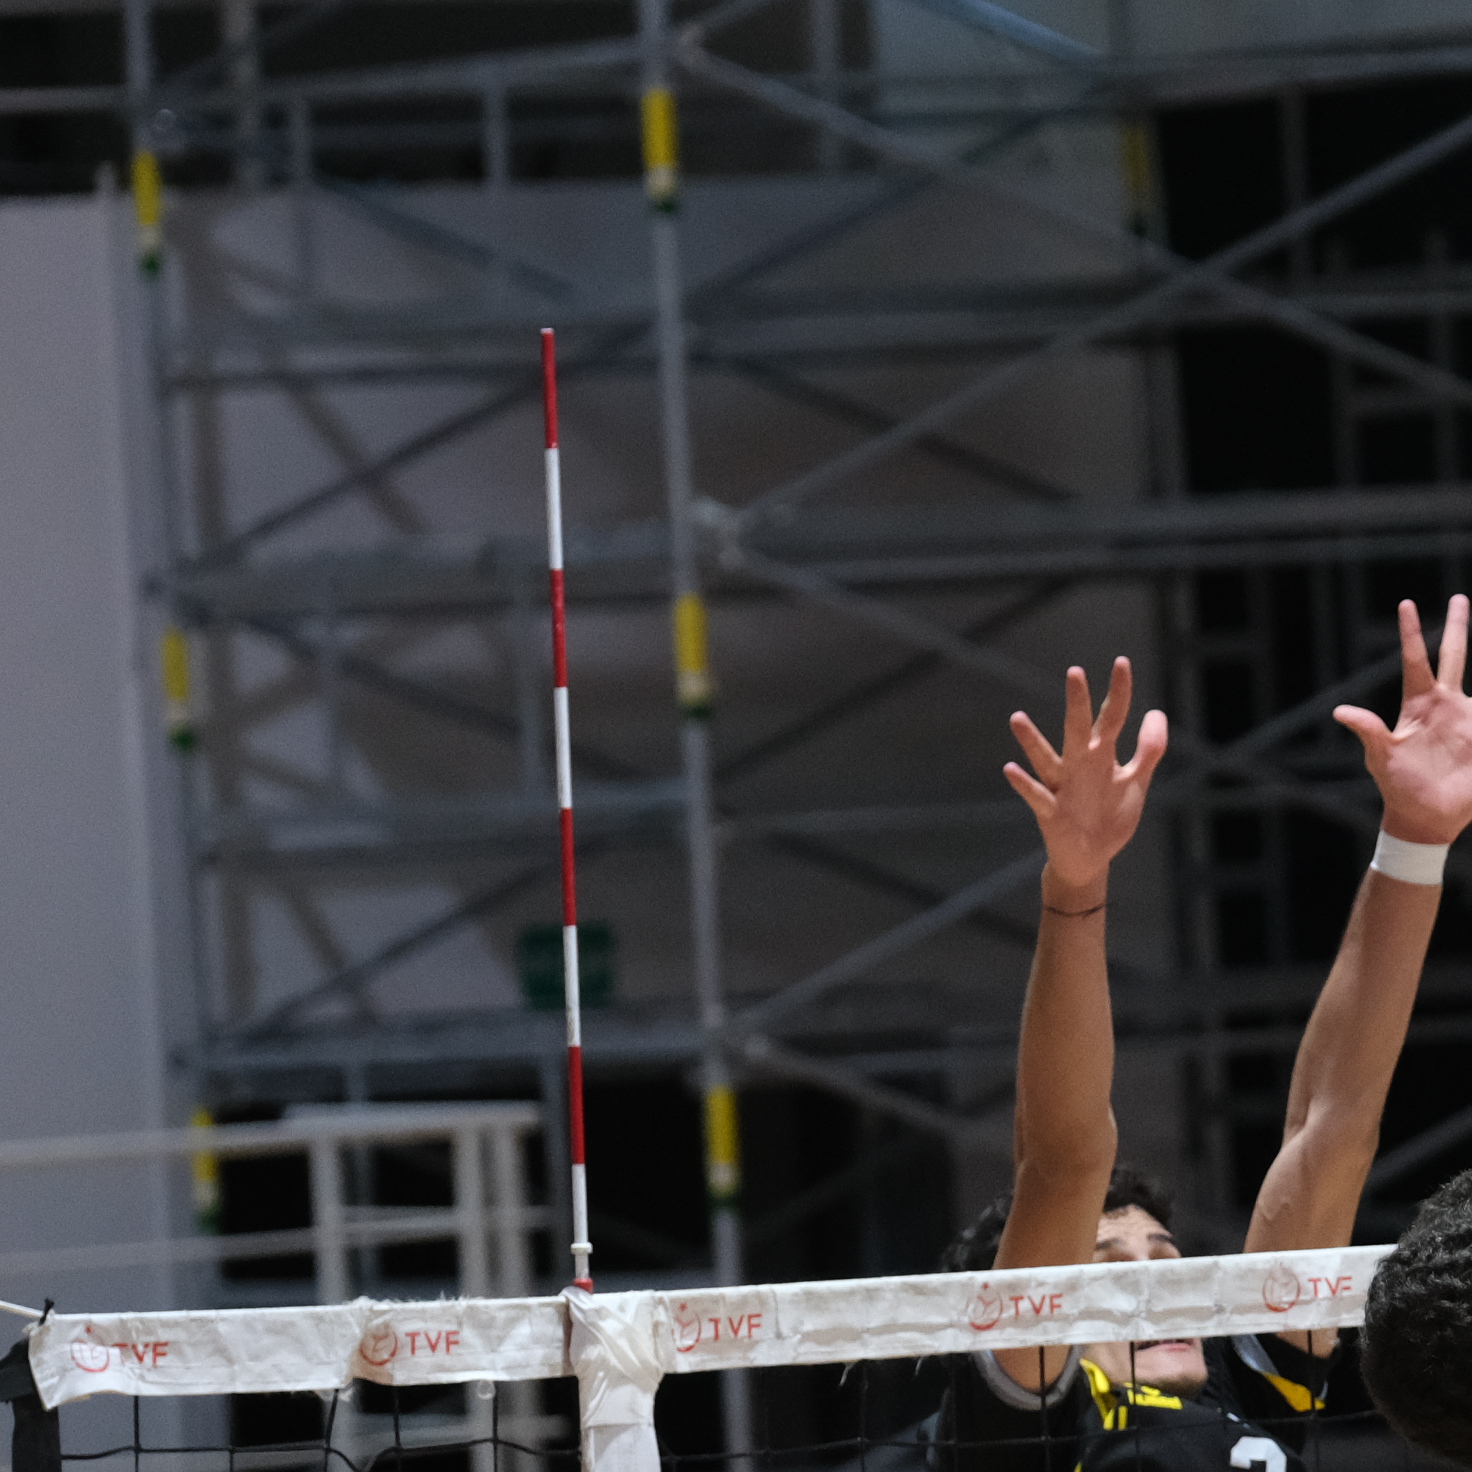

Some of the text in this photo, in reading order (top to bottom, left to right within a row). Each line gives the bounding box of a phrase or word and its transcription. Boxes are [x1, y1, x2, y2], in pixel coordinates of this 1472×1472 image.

[1308, 1276, 1353, 1298] TVF
[1009, 1293, 1064, 1320] TVF
[708, 1313, 763, 1341] TVF
[112, 1341, 169, 1369] TVF
[405, 1330, 461, 1356] TVF
